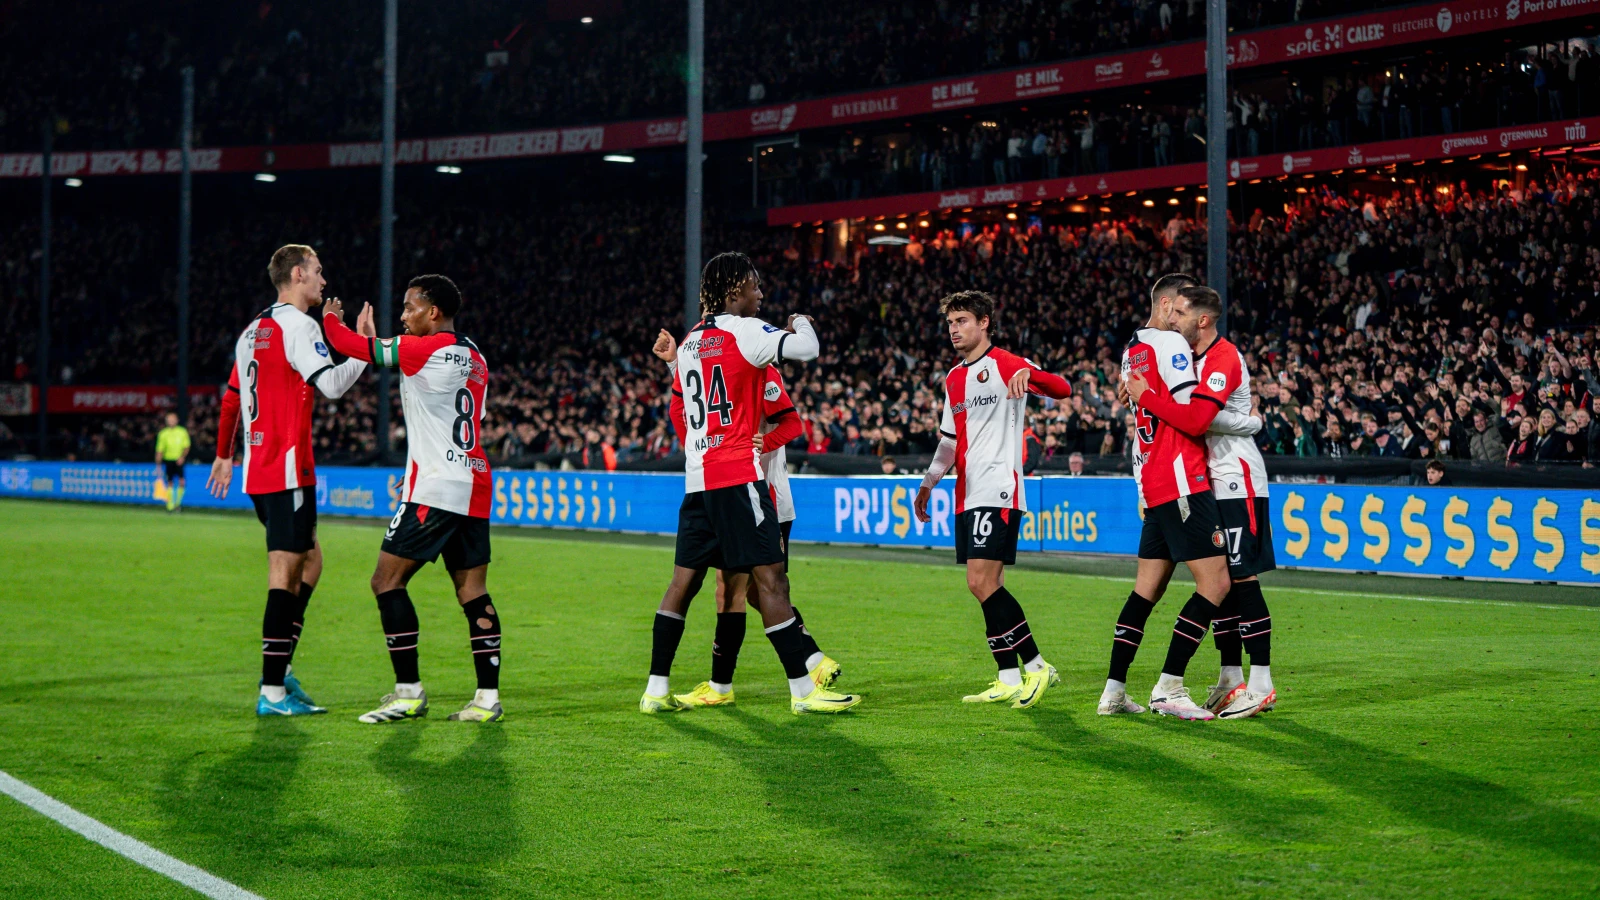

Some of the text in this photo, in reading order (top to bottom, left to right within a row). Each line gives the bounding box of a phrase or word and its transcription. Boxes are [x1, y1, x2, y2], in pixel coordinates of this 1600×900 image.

[1524, 0, 1545, 13] Port
[1392, 8, 1499, 33] FLETCHER HOTELS
[1286, 27, 1322, 57] SPIE
[1347, 23, 1380, 44] CALEX
[931, 84, 949, 100] DE
[1015, 72, 1033, 88] DE
[832, 96, 899, 119] RIVERDALE
[560, 126, 605, 152] 1970
[1500, 128, 1548, 148] QTERMINALS
[1564, 123, 1586, 141] TOTO
[1442, 136, 1488, 154] QTERMINALS
[246, 358, 260, 424] 3
[1209, 377, 1225, 387] TOTO
[686, 363, 734, 431] 34
[453, 387, 475, 452] 8
[390, 503, 407, 530] 8
[972, 511, 993, 537] 16
[1017, 501, 1099, 543] anties
[1223, 527, 1244, 554] 17
